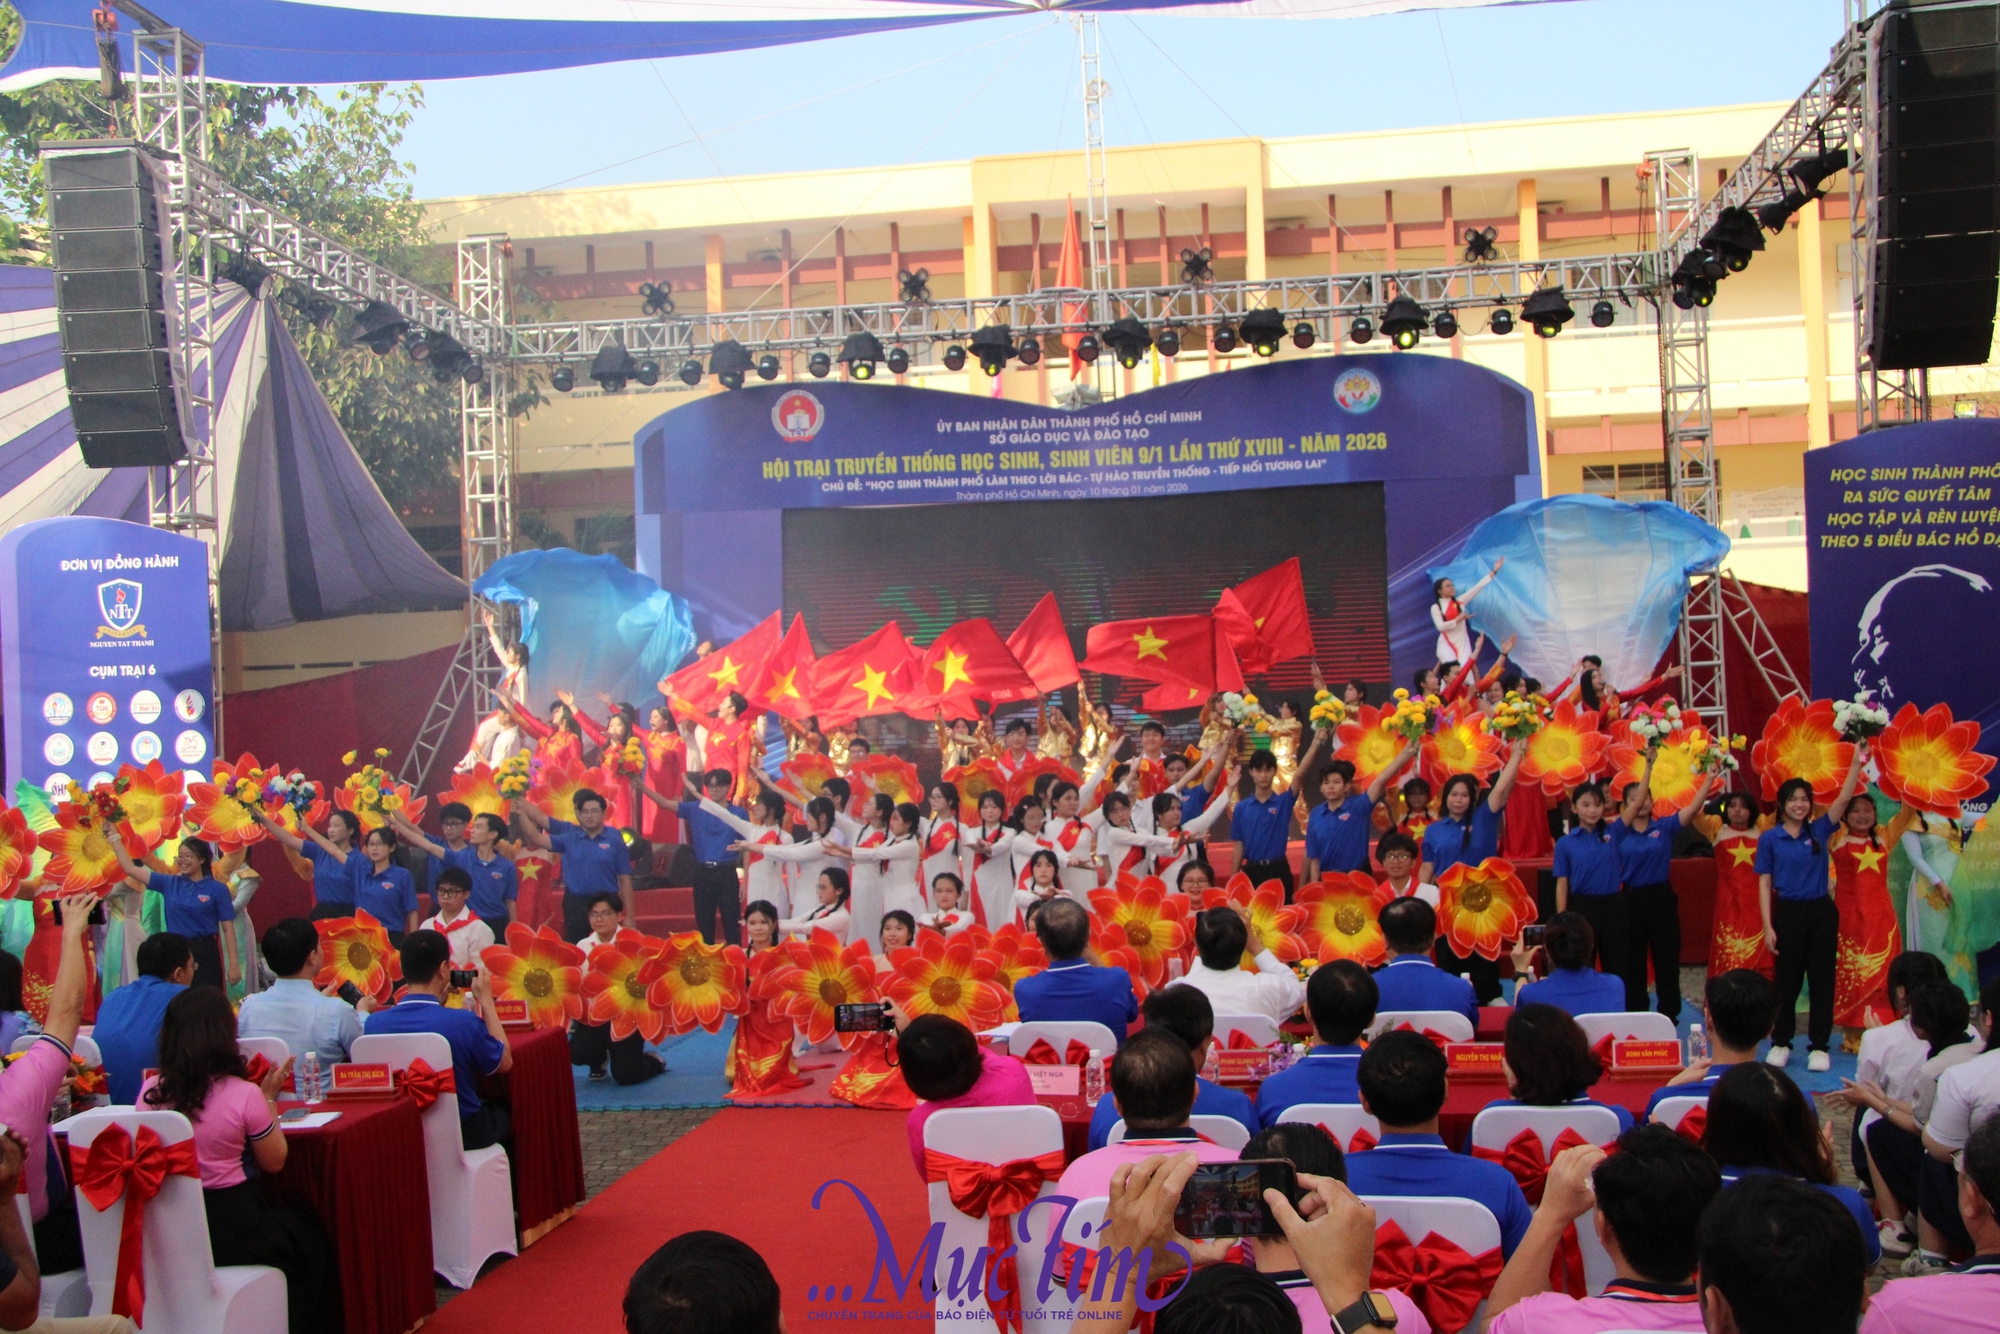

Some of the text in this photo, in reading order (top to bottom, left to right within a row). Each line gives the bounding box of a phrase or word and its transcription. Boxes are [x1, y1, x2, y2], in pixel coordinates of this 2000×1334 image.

[937, 410, 1202, 432] ỦY BAN NHÂN DÂN THÀNH PHỐ HỒ CHÍ MINH
[990, 427, 1149, 445] SỞ GIÁO DỤC VÀ ĐÀO TẠO
[763, 458, 790, 482] HỘI
[794, 459, 830, 480] TRẠI
[835, 451, 897, 476] TRUYỀN
[902, 449, 956, 472] THỐNG
[961, 452, 994, 474] HỌC
[1000, 451, 1045, 470] SINH,
[1050, 449, 1090, 468] SINH
[1095, 444, 1133, 466] VIÊN
[1138, 446, 1163, 464] 9/1
[1170, 438, 1203, 463] LẦN
[1208, 436, 1241, 459] THỨ
[1245, 437, 1284, 457] XVIII
[1301, 431, 1340, 453] NĂM
[1346, 432, 1387, 451] 2026
[822, 479, 844, 492] CHỦ
[846, 477, 863, 491] ĐỀ:
[897, 479, 921, 490] SINH
[924, 476, 958, 488] THÀNH
[961, 474, 983, 487] PHỐ
[986, 474, 1008, 486] LÀM
[1010, 474, 1037, 485] THEO
[1040, 472, 1057, 484] LỜI
[1059, 471, 1081, 484] BÁC
[1090, 470, 1103, 485] TỰ
[1106, 470, 1129, 482] HÀO
[1132, 466, 1170, 480] TRUYỀN
[1172, 465, 1210, 478] THỐNG
[1219, 461, 1240, 475] TIẾP
[1242, 461, 1263, 474] NỐI
[1266, 459, 1303, 472] TƯƠNG
[1830, 468, 1866, 483] HỌC
[1871, 468, 1907, 481] SINH
[1912, 464, 1965, 480] THÀNH
[956, 490, 983, 500] Thành
[985, 489, 1004, 502] phố
[1006, 487, 1018, 499] Hồ
[1020, 488, 1035, 499] Chí
[1063, 488, 1087, 500] ngày
[1090, 487, 1100, 497] 10
[1102, 485, 1129, 498] tháng
[1131, 485, 1141, 494] 01
[1144, 483, 1165, 494] năm
[1167, 482, 1188, 492] 2026
[1844, 484, 1992, 503] RA SỨC QUYẾT TÂM
[1827, 512, 1863, 528] HỌC
[1868, 510, 1897, 527] TẬP
[1902, 509, 1922, 524] VÀ
[1928, 508, 1957, 524] RÈN
[1821, 535, 1860, 548] THEO
[1863, 535, 1874, 548] 5
[1878, 529, 1912, 547] ĐIỀU
[1917, 531, 1950, 547] BÁC
[1954, 527, 1980, 546] HỒ
[60, 554, 179, 573] ĐƠN VỊ ĐỒNG HÀNH
[108, 604, 134, 619] NTT
[90, 640, 117, 648] NGUYEN
[132, 639, 155, 647] THANH
[90, 664, 157, 679] CỤM TRẠI 6
